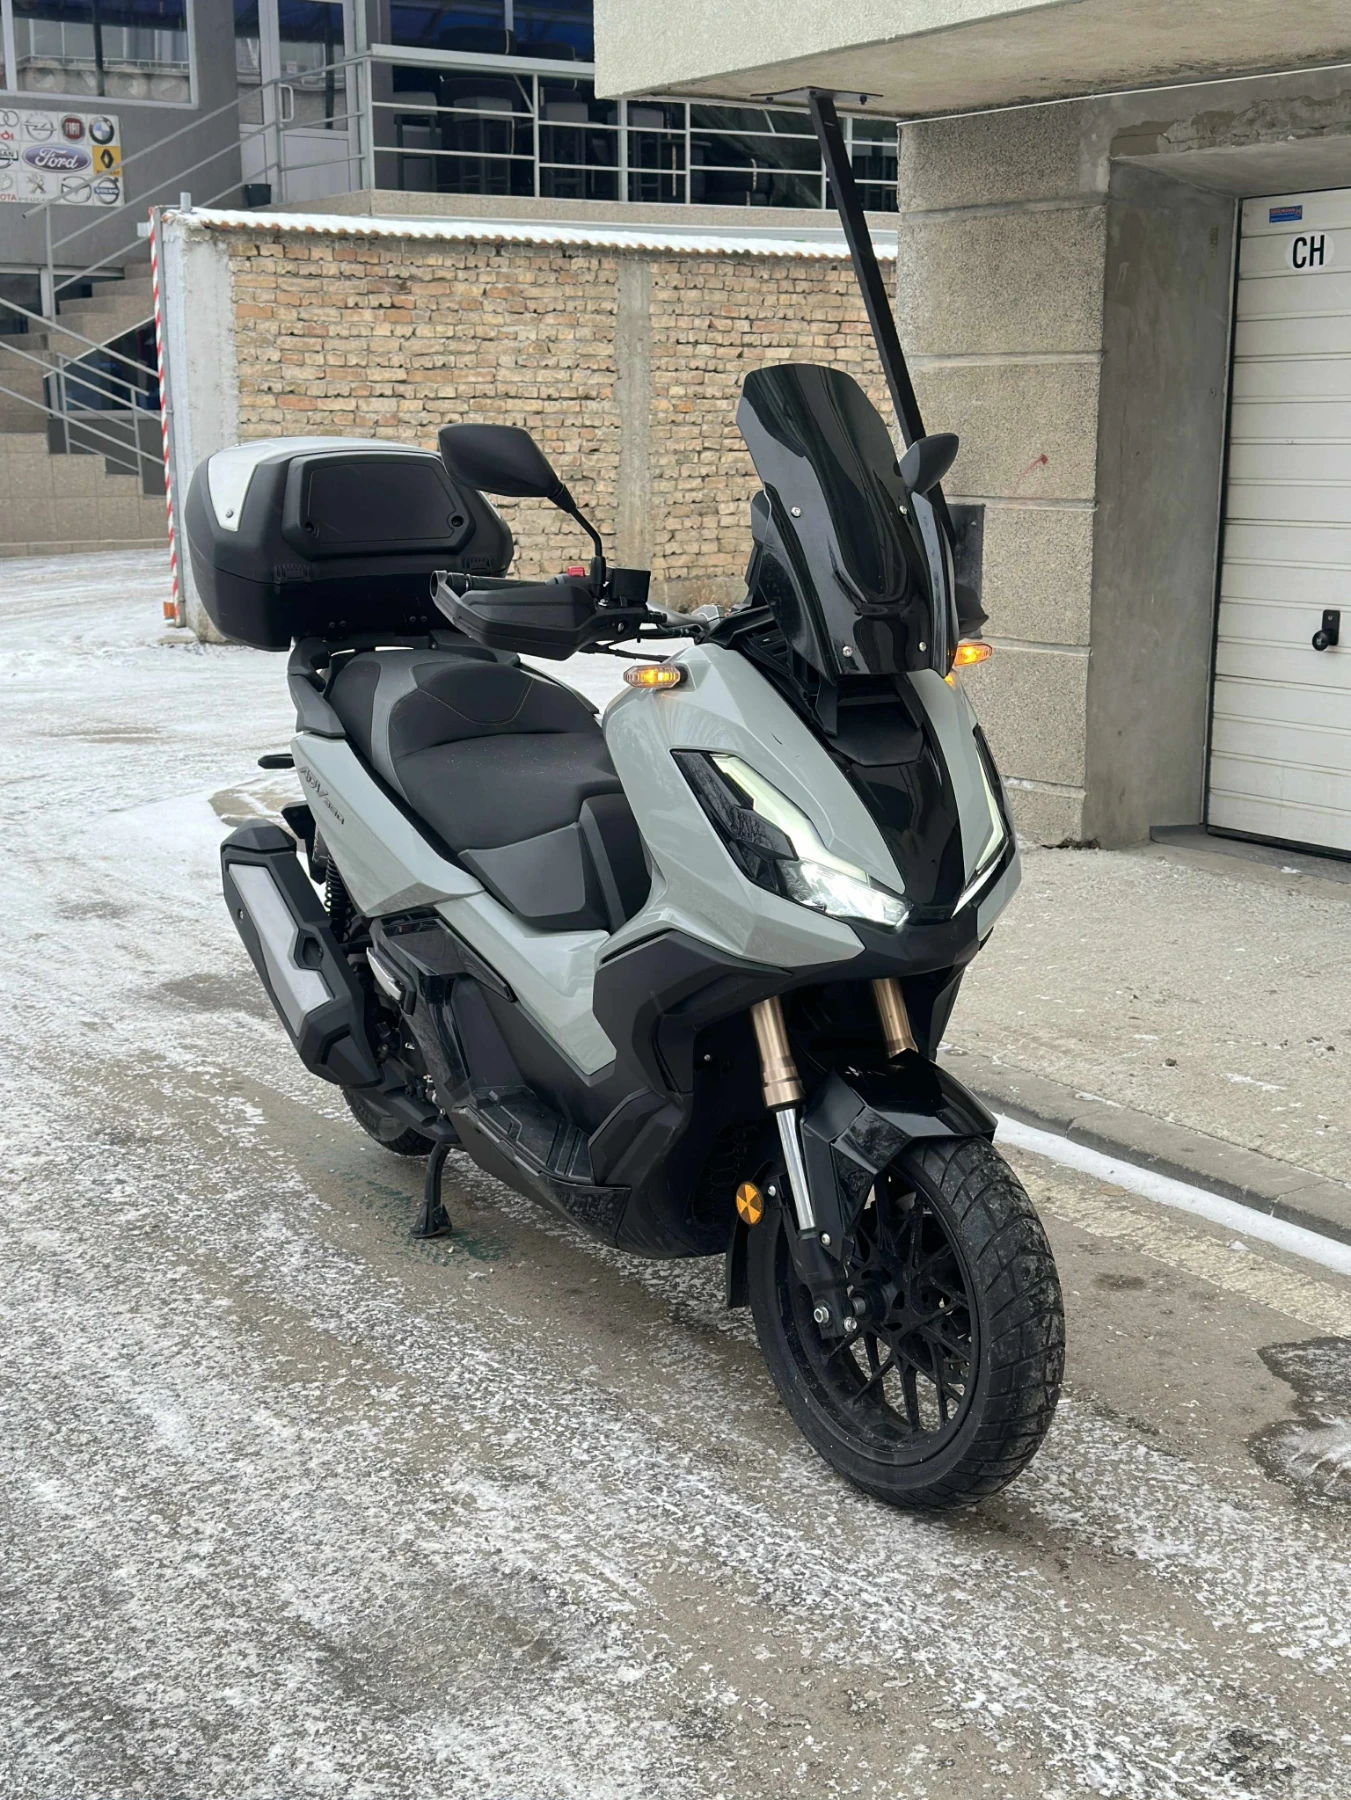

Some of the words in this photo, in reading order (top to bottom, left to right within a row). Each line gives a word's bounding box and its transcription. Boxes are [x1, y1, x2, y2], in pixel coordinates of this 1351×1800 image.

[65, 122, 80, 136] FIAT
[35, 147, 79, 169] Ford
[0, 193, 17, 201] OTA
[1292, 234, 1325, 269] CH
